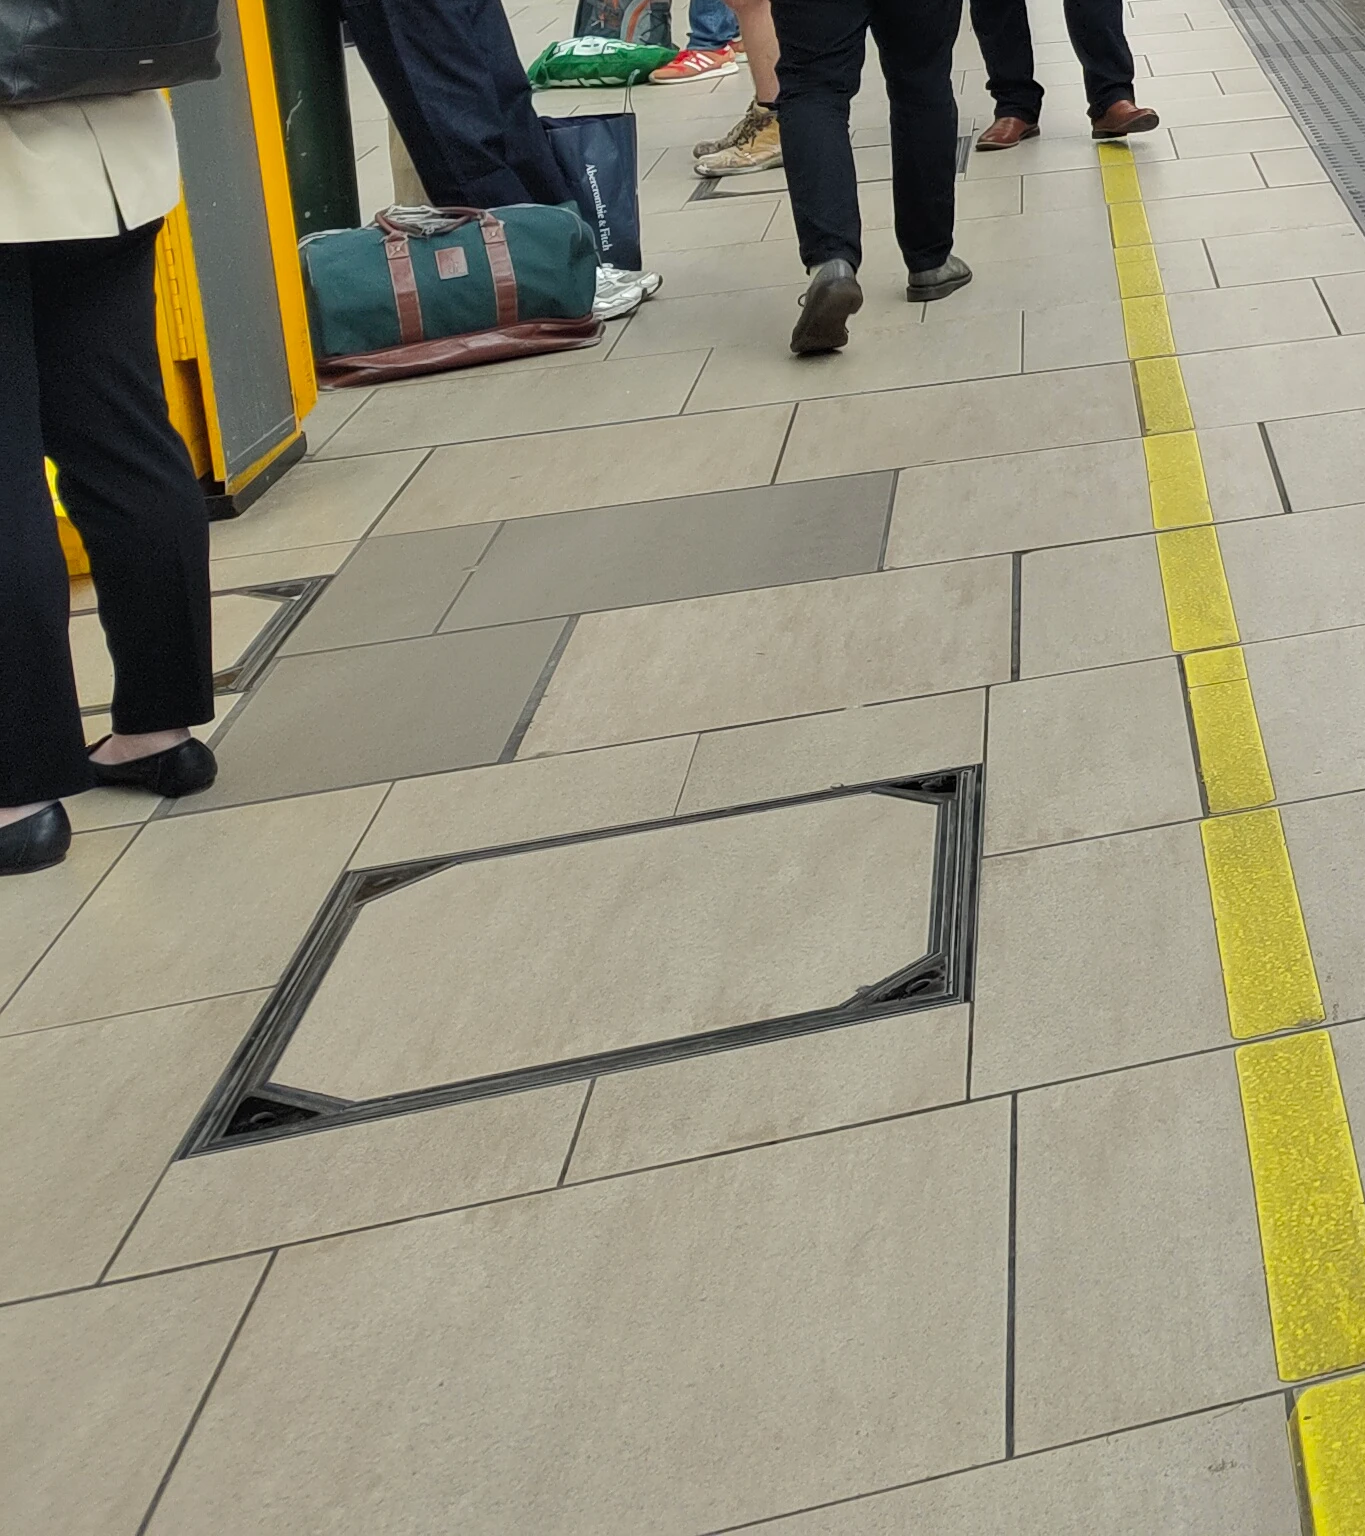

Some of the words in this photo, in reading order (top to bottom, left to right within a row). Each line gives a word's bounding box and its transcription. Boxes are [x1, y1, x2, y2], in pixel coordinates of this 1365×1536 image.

[585, 164, 607, 219] Abercrombie
[598, 219, 607, 227] &
[600, 227, 613, 252] Fitch
